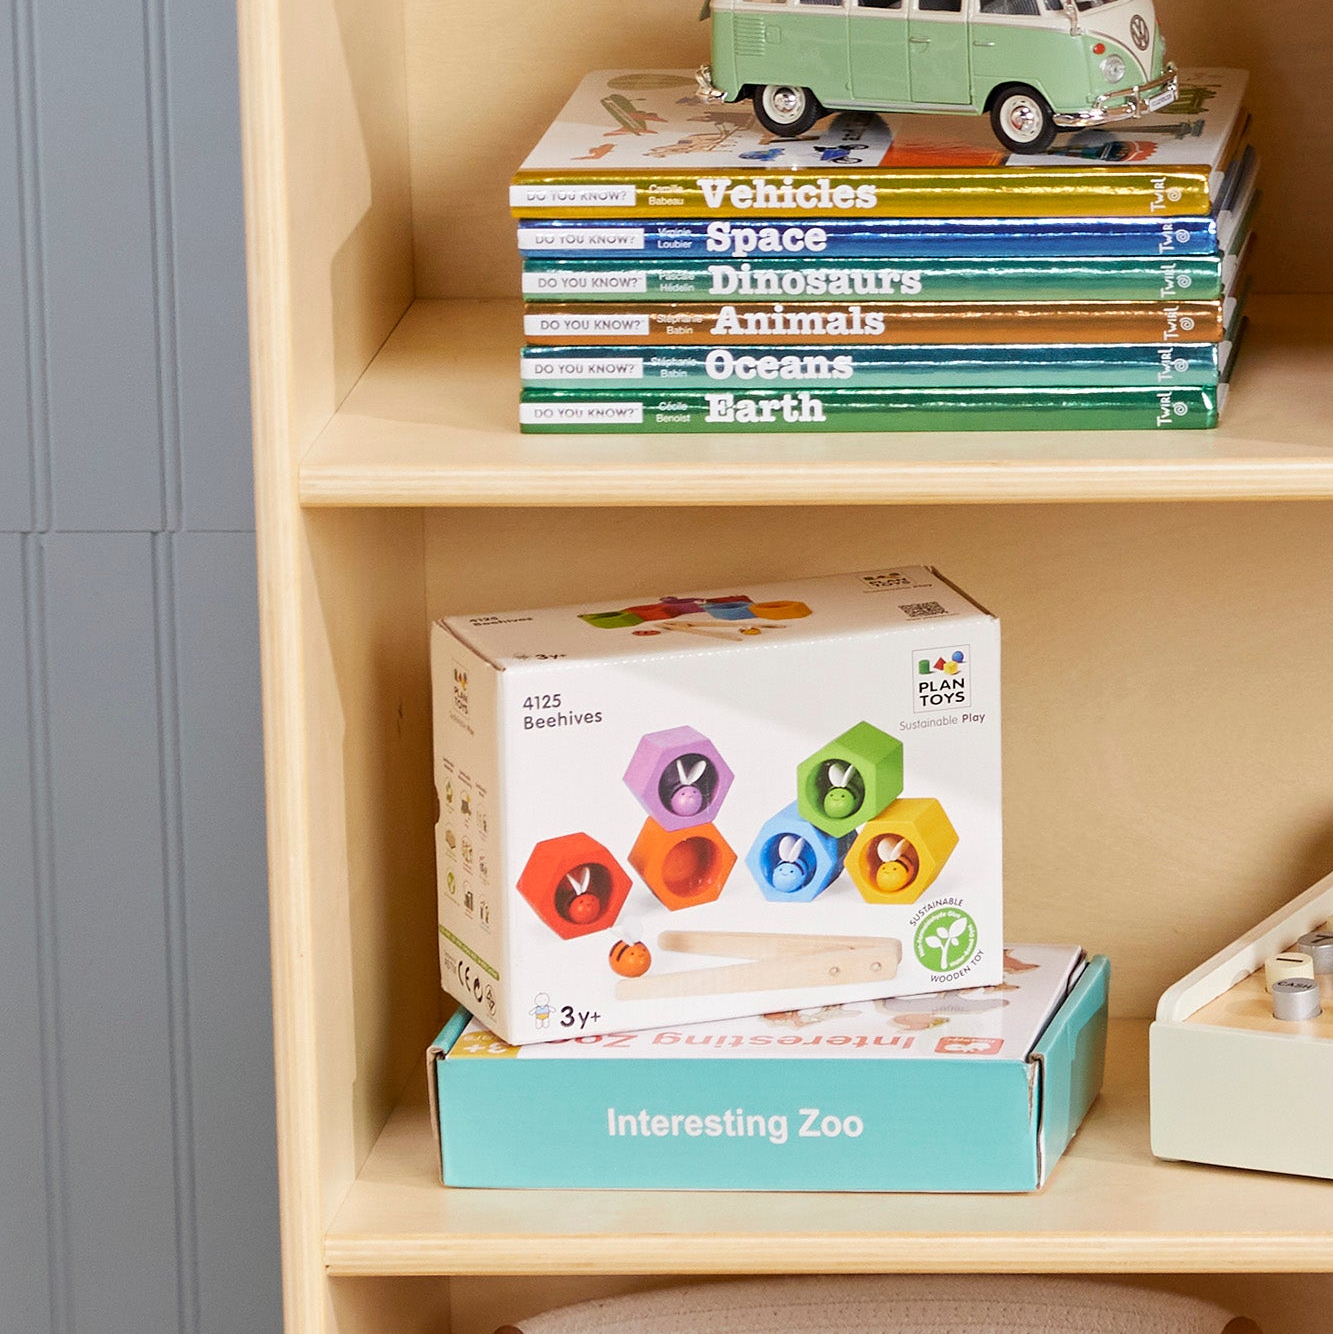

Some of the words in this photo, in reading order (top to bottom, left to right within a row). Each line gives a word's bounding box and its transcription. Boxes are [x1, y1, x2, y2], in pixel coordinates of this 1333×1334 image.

[526, 190, 547, 201] DO
[551, 190, 576, 201] YOU
[581, 190, 627, 201] KNOW?
[697, 179, 877, 208] Vehicles
[535, 233, 556, 244] DO
[559, 233, 584, 244] YOU
[589, 233, 634, 244] KNOW?
[706, 222, 827, 256] Space
[538, 277, 559, 288] DO
[562, 277, 586, 288] YOU
[591, 277, 638, 288] KNOW?
[705, 263, 921, 295] Dinosaurs
[540, 319, 560, 330] DO
[564, 319, 590, 330] YOU
[594, 319, 640, 330] KNOW?
[710, 304, 885, 335] Animals
[535, 363, 555, 374] DO
[558, 363, 584, 374] YOU
[588, 363, 635, 374] KNOW?
[705, 349, 853, 380] Oceans
[534, 408, 555, 418] DO
[558, 408, 584, 418] YOU
[588, 408, 635, 418] KNOW?
[704, 392, 826, 423] Earth
[919, 678, 965, 693] PLAN
[523, 693, 562, 711] 4125
[919, 691, 965, 706] TOYS
[523, 711, 603, 730] Beehives
[900, 714, 958, 731] Sustainable
[961, 713, 986, 725] Play
[909, 898, 963, 926] SUSTAINABLE
[930, 965, 971, 983] WOODEN
[971, 950, 984, 966] TOY
[560, 1005, 602, 1029] 3y+
[608, 1107, 788, 1145] Interesting
[799, 1107, 864, 1137] Zoo
